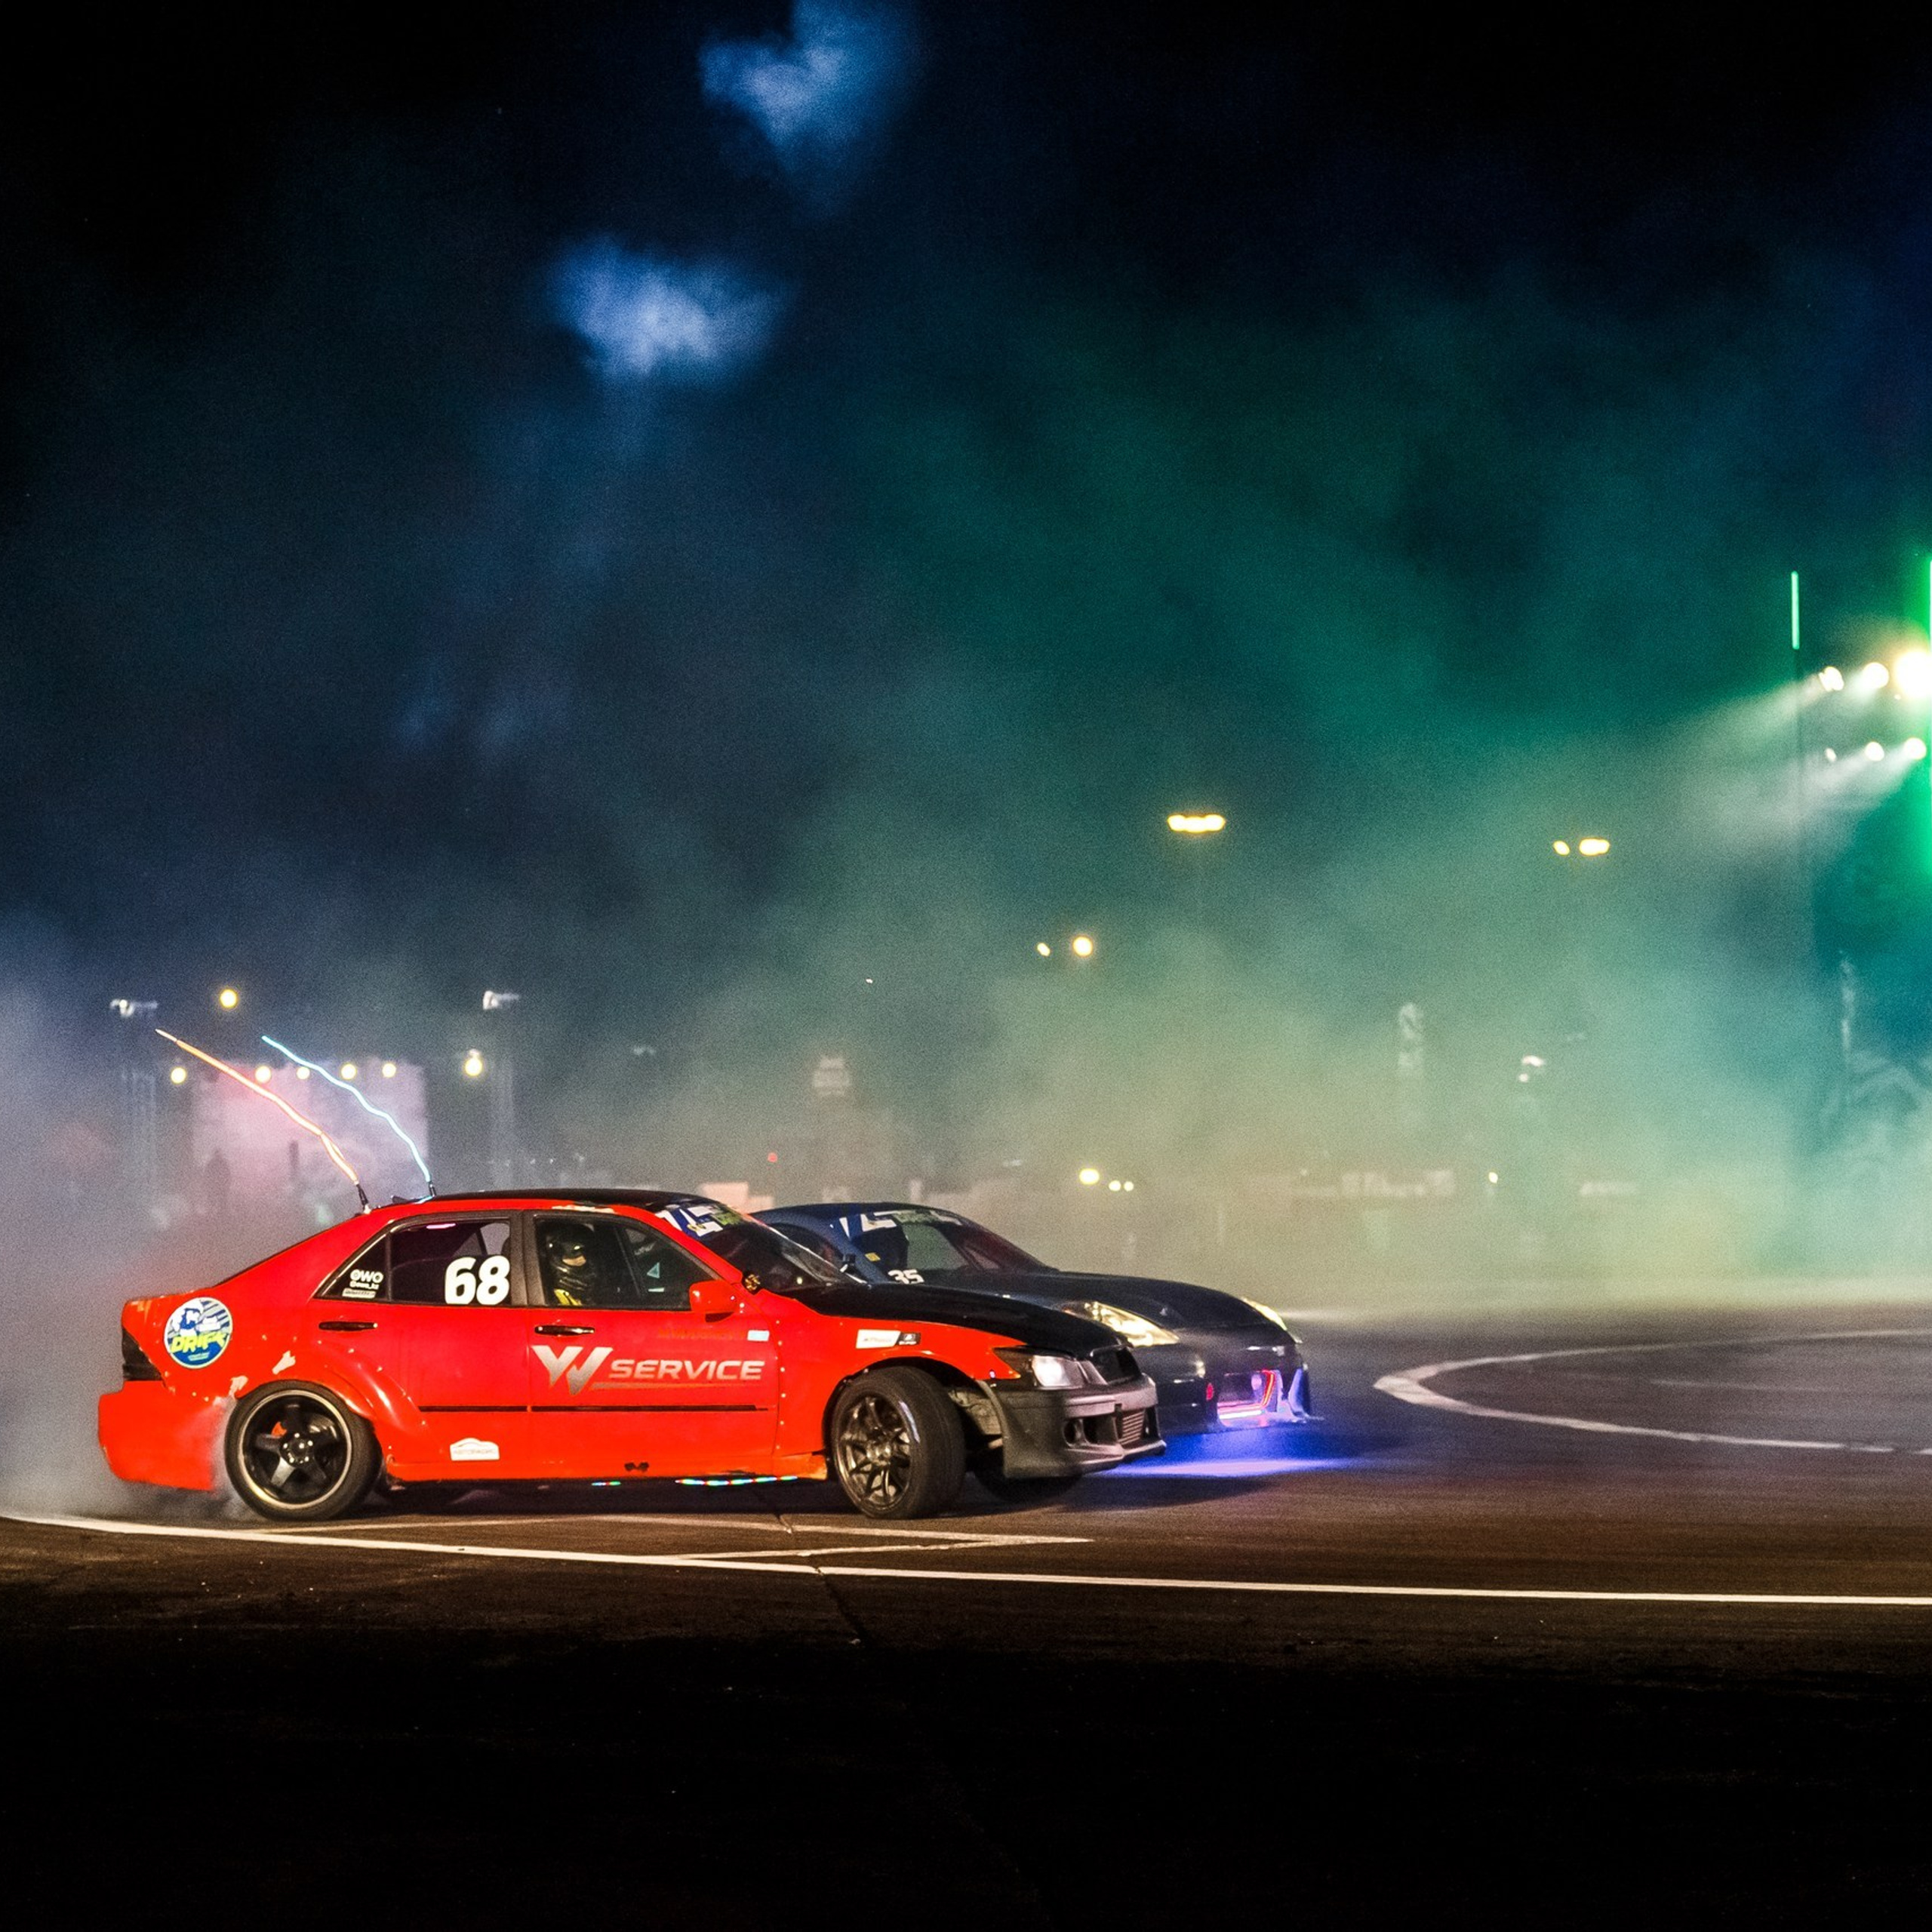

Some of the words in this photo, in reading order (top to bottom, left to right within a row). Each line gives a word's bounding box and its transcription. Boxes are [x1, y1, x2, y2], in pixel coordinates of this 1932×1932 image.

[445, 1255, 510, 1305] 68
[888, 1269, 924, 1284] 35
[609, 1359, 765, 1380] SERVICE
